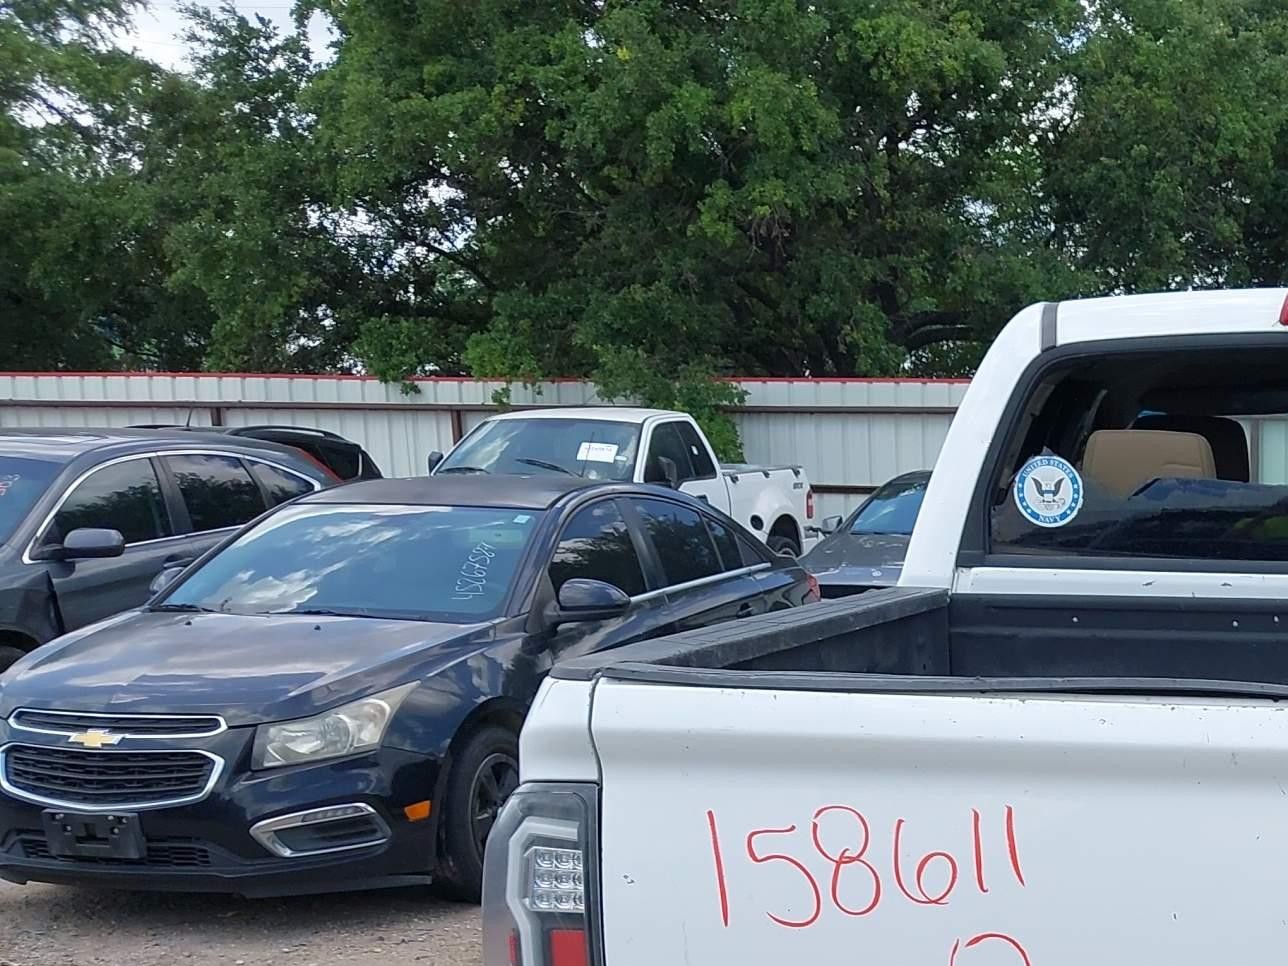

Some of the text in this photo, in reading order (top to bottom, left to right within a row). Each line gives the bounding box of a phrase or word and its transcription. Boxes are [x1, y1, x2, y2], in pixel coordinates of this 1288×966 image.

[1022, 459, 1074, 478] UNITED STATES
[1038, 515, 1061, 524] NAVY
[706, 804, 1026, 928] 158611
